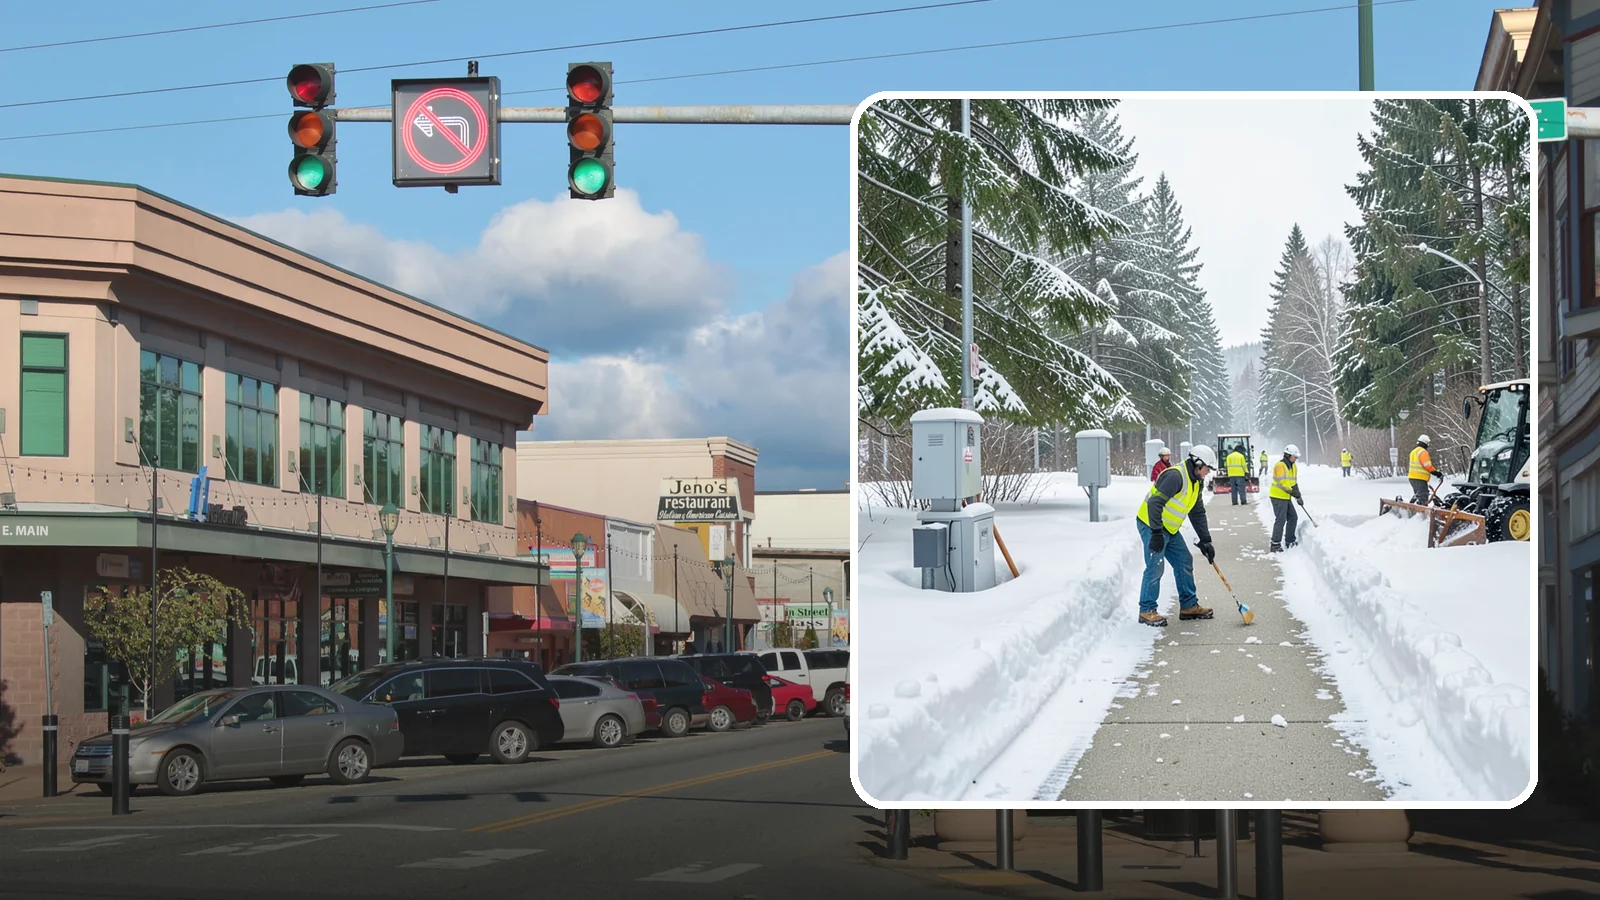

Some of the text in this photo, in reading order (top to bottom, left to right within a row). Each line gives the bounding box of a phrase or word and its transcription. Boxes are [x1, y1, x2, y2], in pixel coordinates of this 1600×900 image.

[670, 480, 727, 494] Jeno's
[665, 497, 731, 509] restaurant
[686, 510, 714, 519] American
[715, 509, 737, 519] Cuisine
[2, 525, 48, 536] E. MAIN
[797, 608, 828, 616] Street
[790, 619, 823, 627] lass
